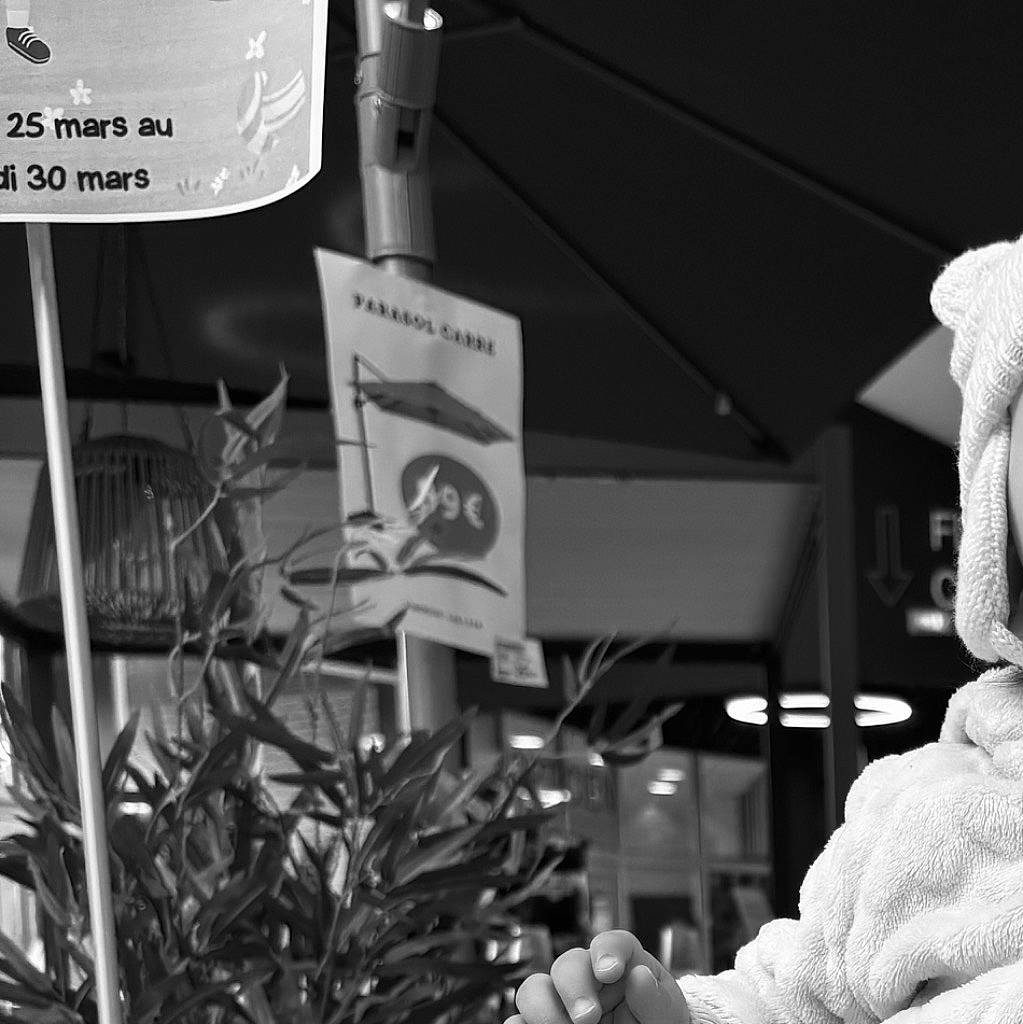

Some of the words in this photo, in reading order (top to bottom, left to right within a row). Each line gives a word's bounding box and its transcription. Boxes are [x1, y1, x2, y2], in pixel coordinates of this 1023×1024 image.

[7, 112, 44, 138] 25
[54, 116, 128, 139] mars
[138, 117, 173, 138] au
[27, 164, 66, 191] 30
[77, 168, 150, 192] mars
